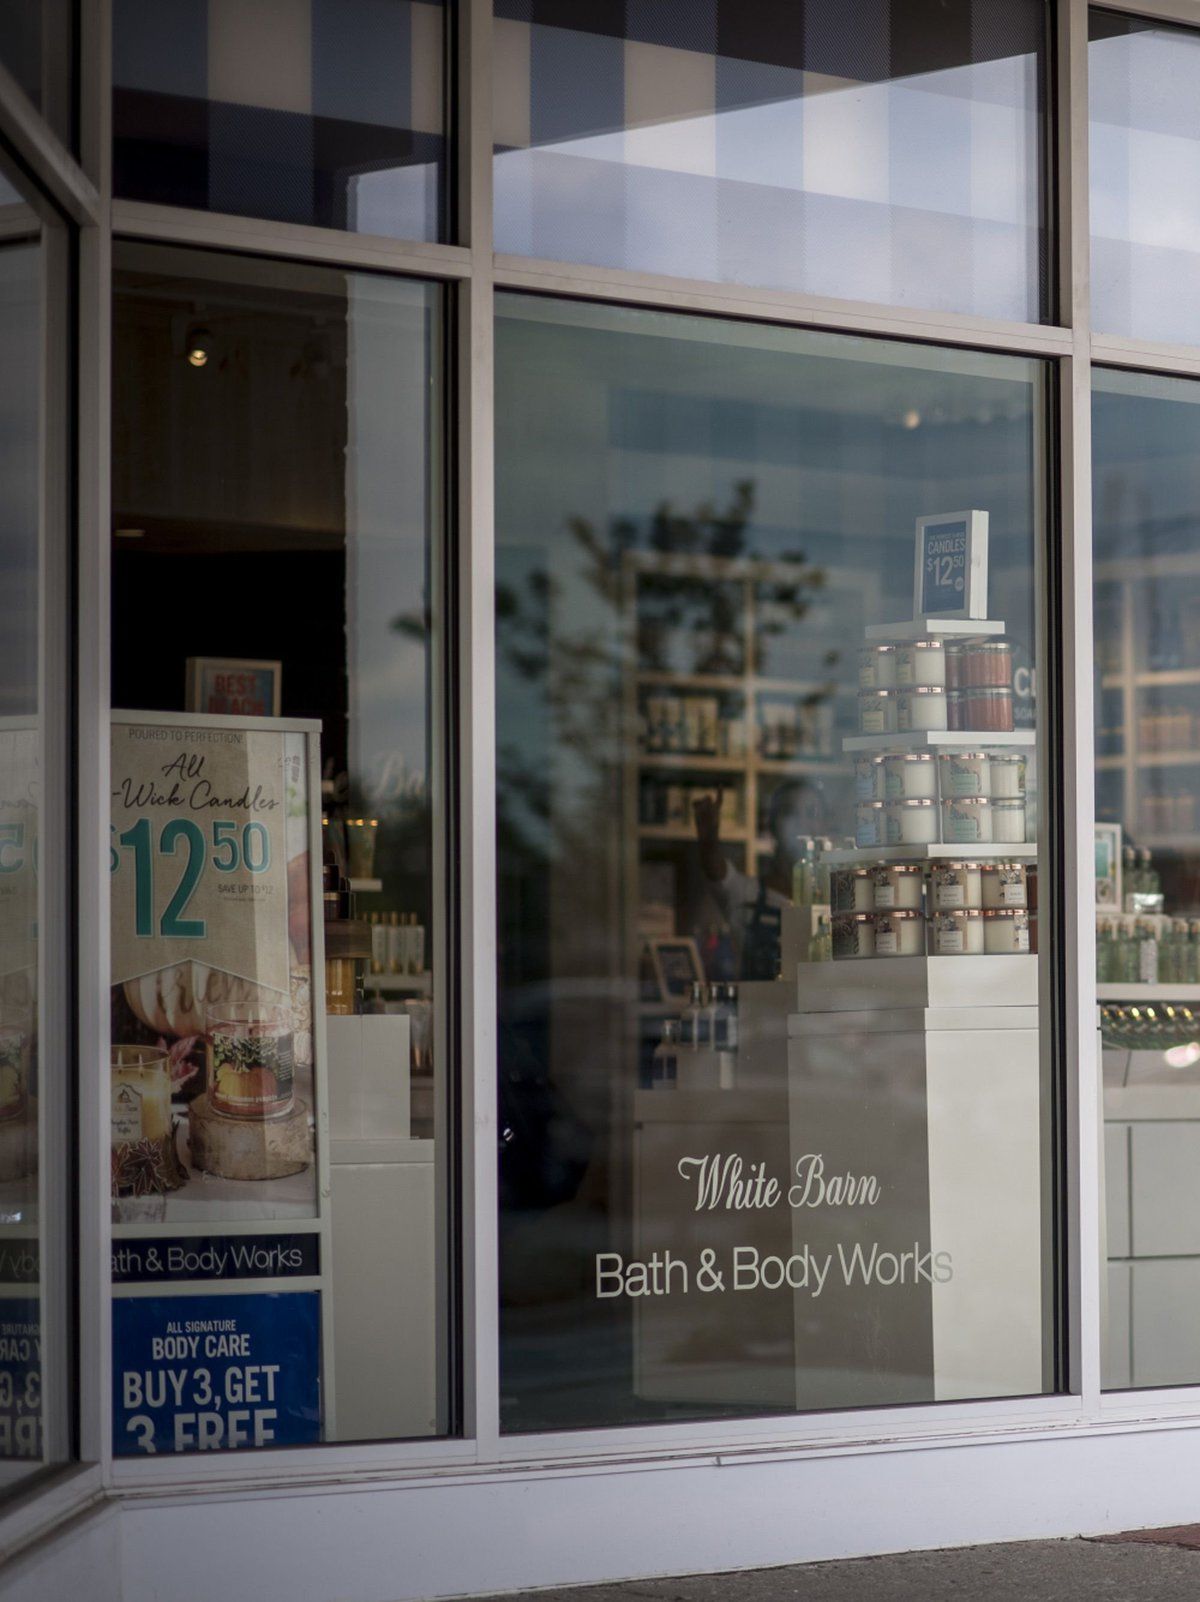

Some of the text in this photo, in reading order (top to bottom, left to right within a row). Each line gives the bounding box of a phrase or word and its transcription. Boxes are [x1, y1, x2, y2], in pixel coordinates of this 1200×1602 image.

[927, 538, 966, 556] CANDLES
[128, 728, 167, 742] POURED
[169, 729, 182, 742] TO
[162, 753, 205, 782] All
[111, 778, 281, 813] -Wick Candles
[217, 883, 236, 895] SAVE
[238, 884, 248, 895] UP
[677, 1153, 882, 1211] White Barn
[146, 1247, 163, 1273] &
[168, 1246, 228, 1276] Body
[230, 1244, 303, 1270] Works
[595, 1241, 954, 1299] Bath & Body Works
[166, 1319, 237, 1334] ALL SIGNATURE
[152, 1333, 251, 1361] BODY CARE
[123, 1368, 188, 1410] BUY
[225, 1364, 281, 1403] GET
[126, 1414, 157, 1454] 3
